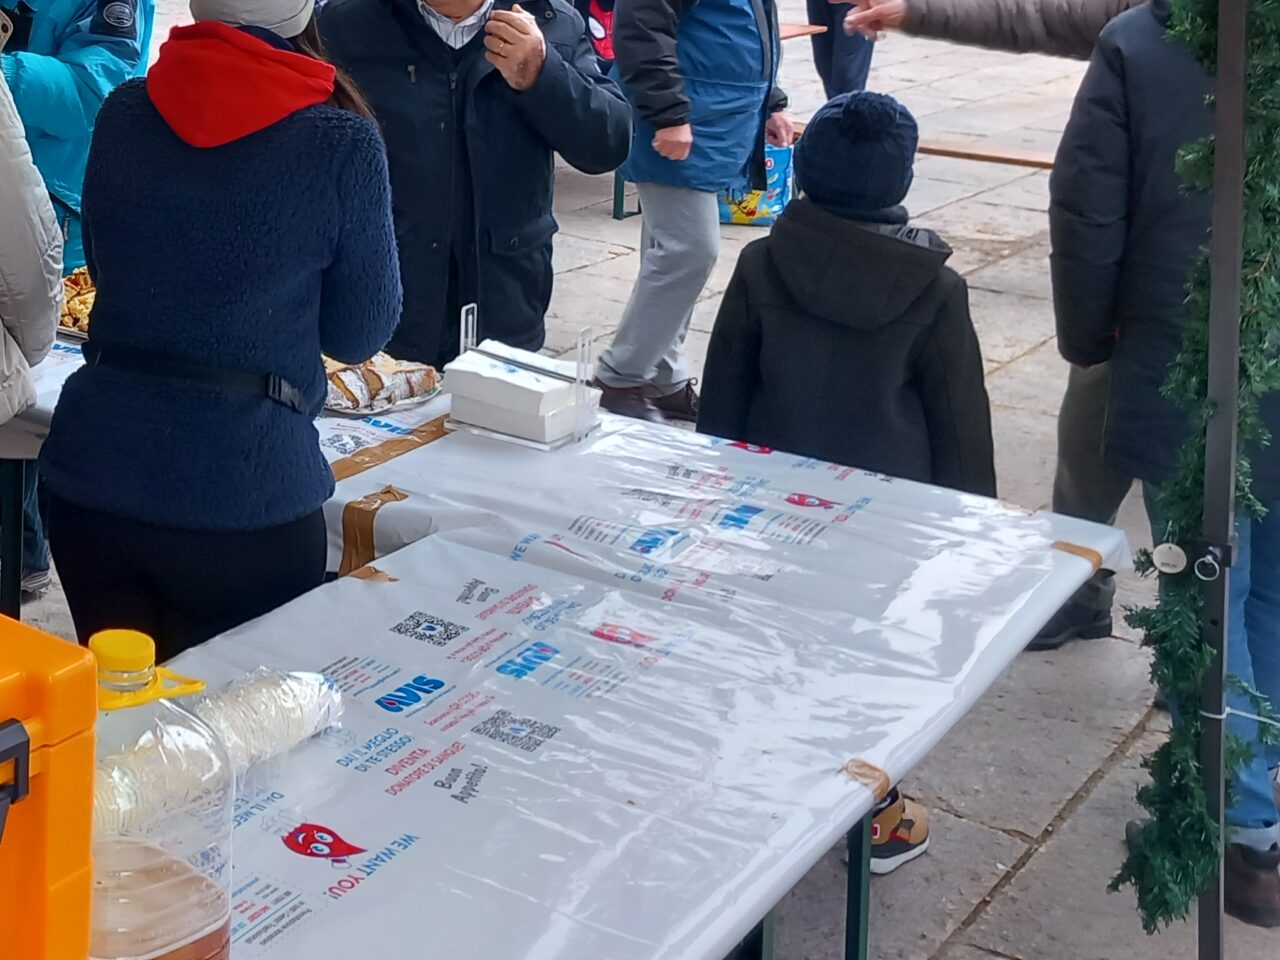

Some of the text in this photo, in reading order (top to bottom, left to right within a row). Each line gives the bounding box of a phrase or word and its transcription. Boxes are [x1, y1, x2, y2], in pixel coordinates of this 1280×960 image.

[374, 674, 445, 713] AVIS
[384, 747, 432, 776] DIVENTA
[433, 767, 463, 790] Buon
[385, 767, 430, 796] DONATORE
[450, 763, 488, 804] Appetito!
[322, 833, 420, 900] WE WANT YOU!
